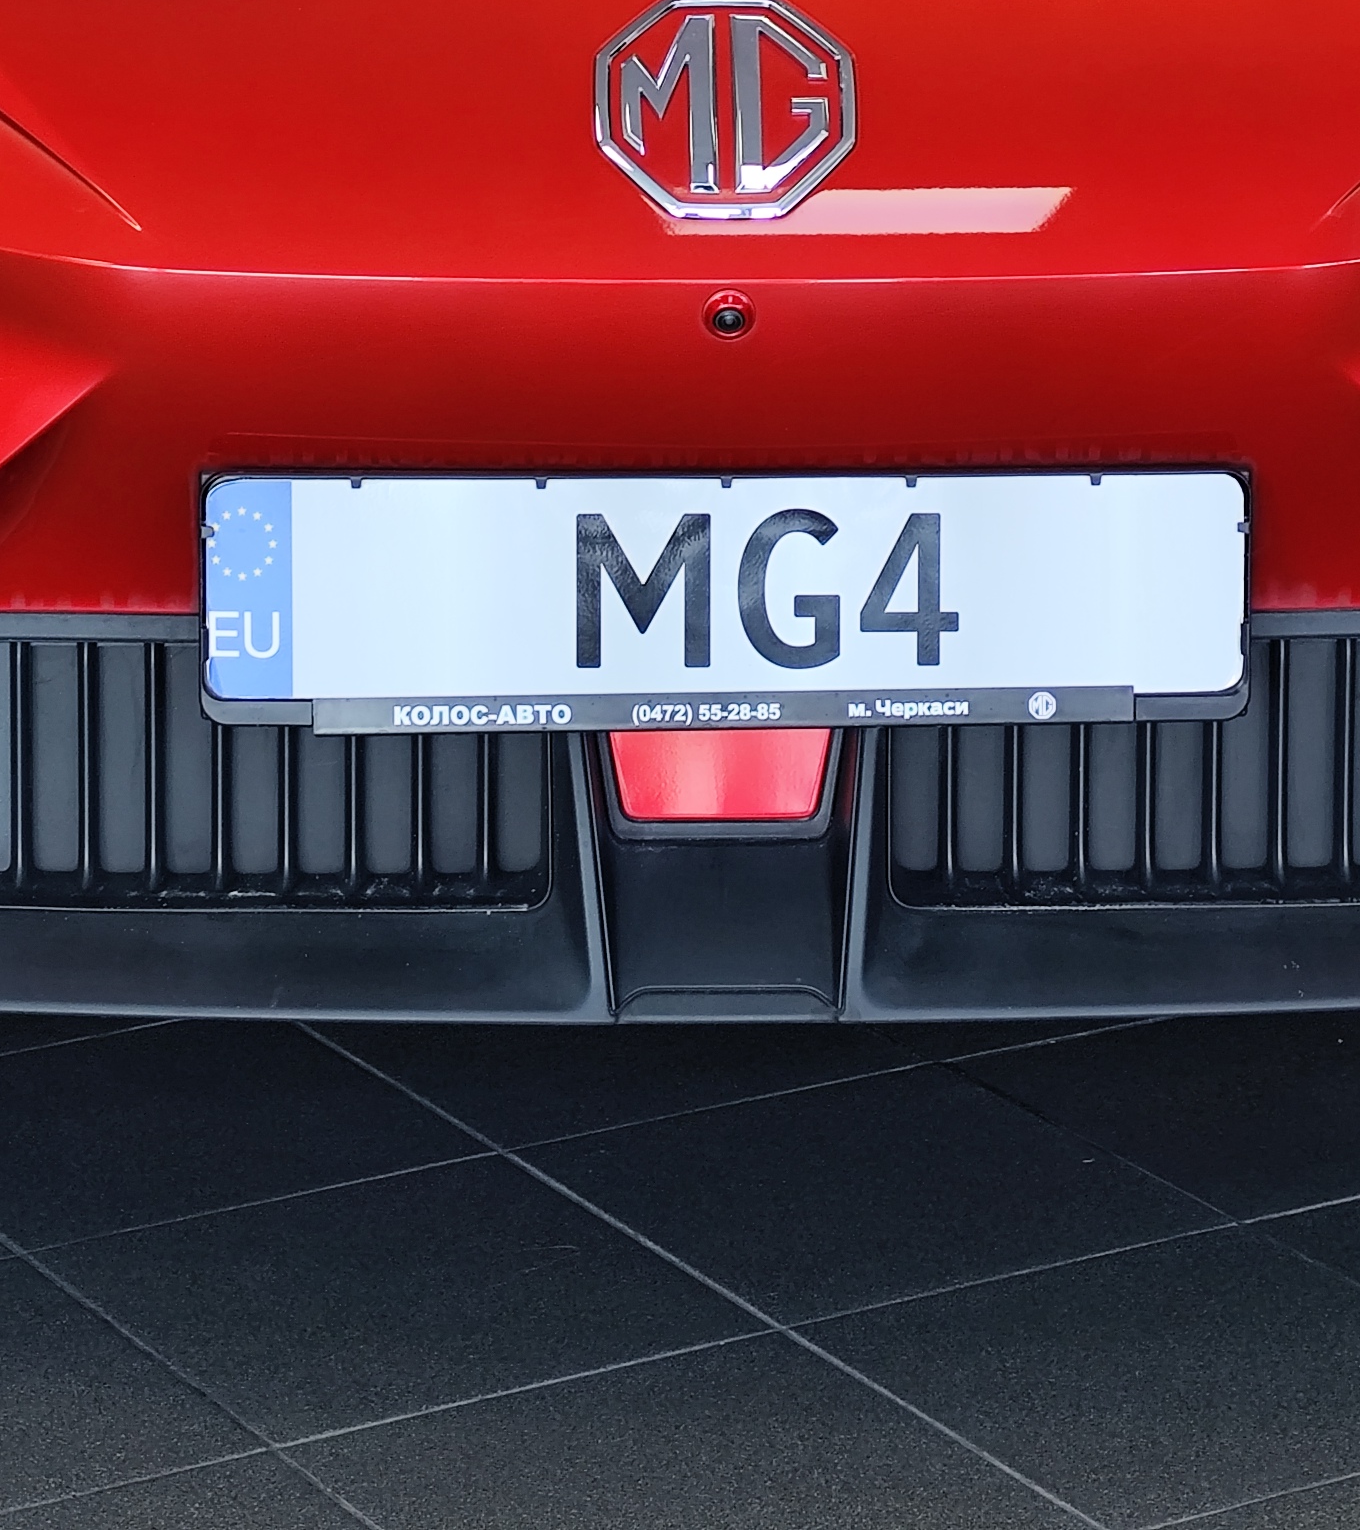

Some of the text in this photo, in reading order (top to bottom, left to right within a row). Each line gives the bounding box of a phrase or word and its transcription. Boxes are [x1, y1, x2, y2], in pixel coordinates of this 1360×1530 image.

[620, 13, 830, 194] MG
[576, 508, 960, 669] MG4
[208, 610, 280, 659] EU
[393, 698, 969, 726] КОЛОС-АВТО (0472) 55-28-85 м. Черкаси
[1030, 693, 1055, 718] MG
